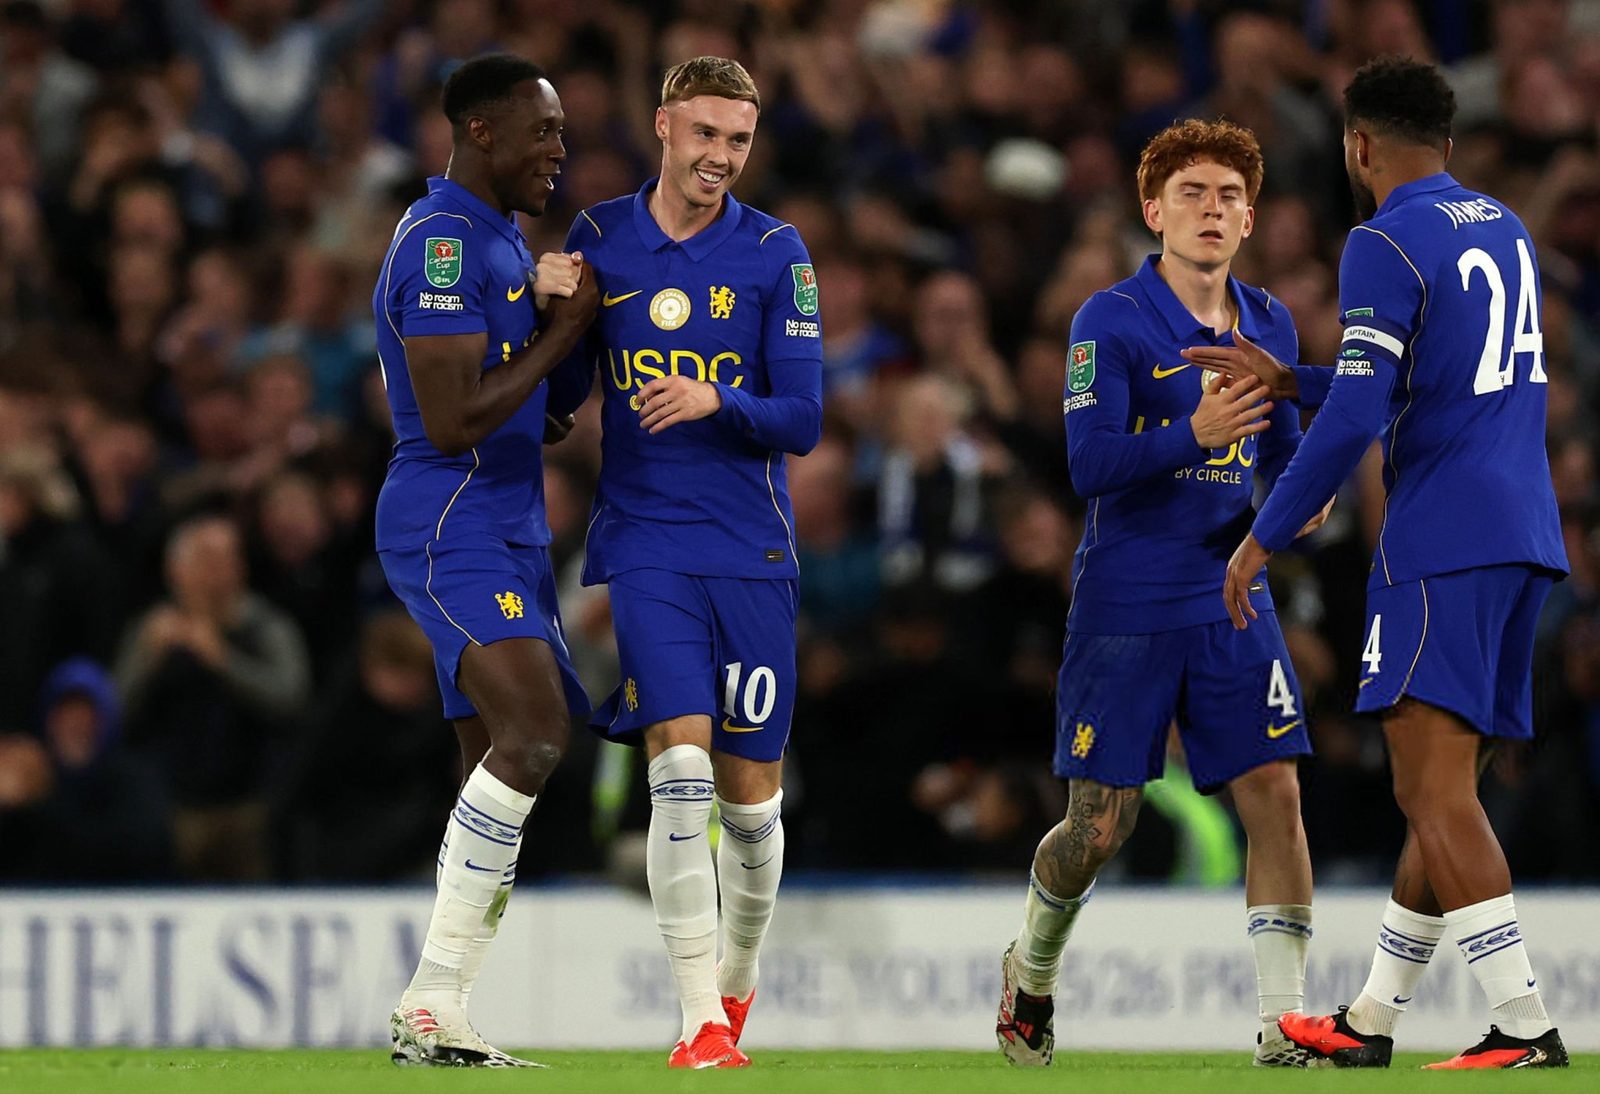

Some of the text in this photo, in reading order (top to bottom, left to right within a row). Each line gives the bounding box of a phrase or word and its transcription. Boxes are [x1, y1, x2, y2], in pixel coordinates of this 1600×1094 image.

[1434, 198, 1503, 230] JAMES
[420, 292, 460, 304] No room
[419, 300, 463, 311] for racism
[1457, 238, 1548, 396] 24
[785, 319, 818, 331] No room
[1346, 329, 1376, 340] CAPTAIN
[608, 348, 744, 391] USDC
[1346, 360, 1371, 369] room
[1345, 368, 1374, 377] racism
[1070, 398, 1097, 411] racism
[1071, 392, 1093, 405] room
[1174, 467, 1242, 485] BY CIRCLE
[724, 661, 777, 725] 10
[1267, 659, 1297, 718] 4
